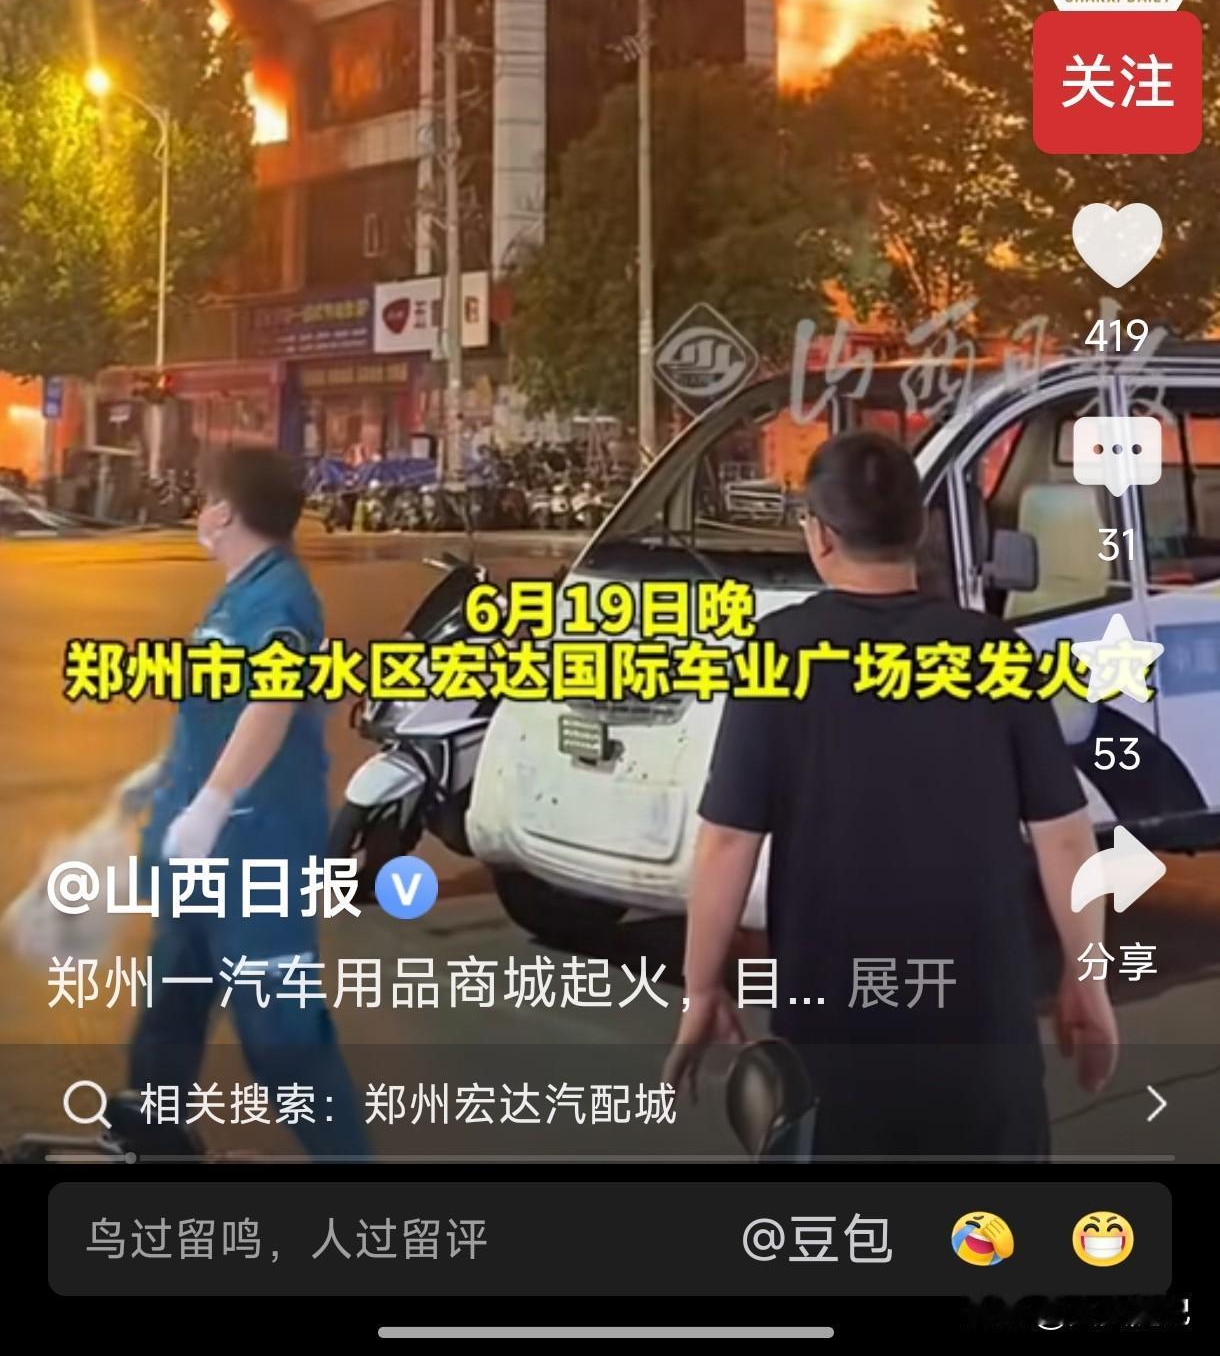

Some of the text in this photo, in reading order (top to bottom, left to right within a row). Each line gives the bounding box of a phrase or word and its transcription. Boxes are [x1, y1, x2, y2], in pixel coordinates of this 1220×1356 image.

[1061, 53, 1175, 109] 关注
[1084, 319, 1149, 352] 419
[1098, 528, 1134, 561] 31
[1094, 737, 1141, 771] 53
[46, 855, 363, 919] @山西日报
[848, 957, 957, 1009] 展开
[1077, 941, 1158, 982] 分享
[140, 1081, 678, 1127] 相关搜索：郑州宏达汽配城
[85, 1215, 489, 1265] 鸟过留鸣，人过留评
[742, 1212, 893, 1264] @豆包
